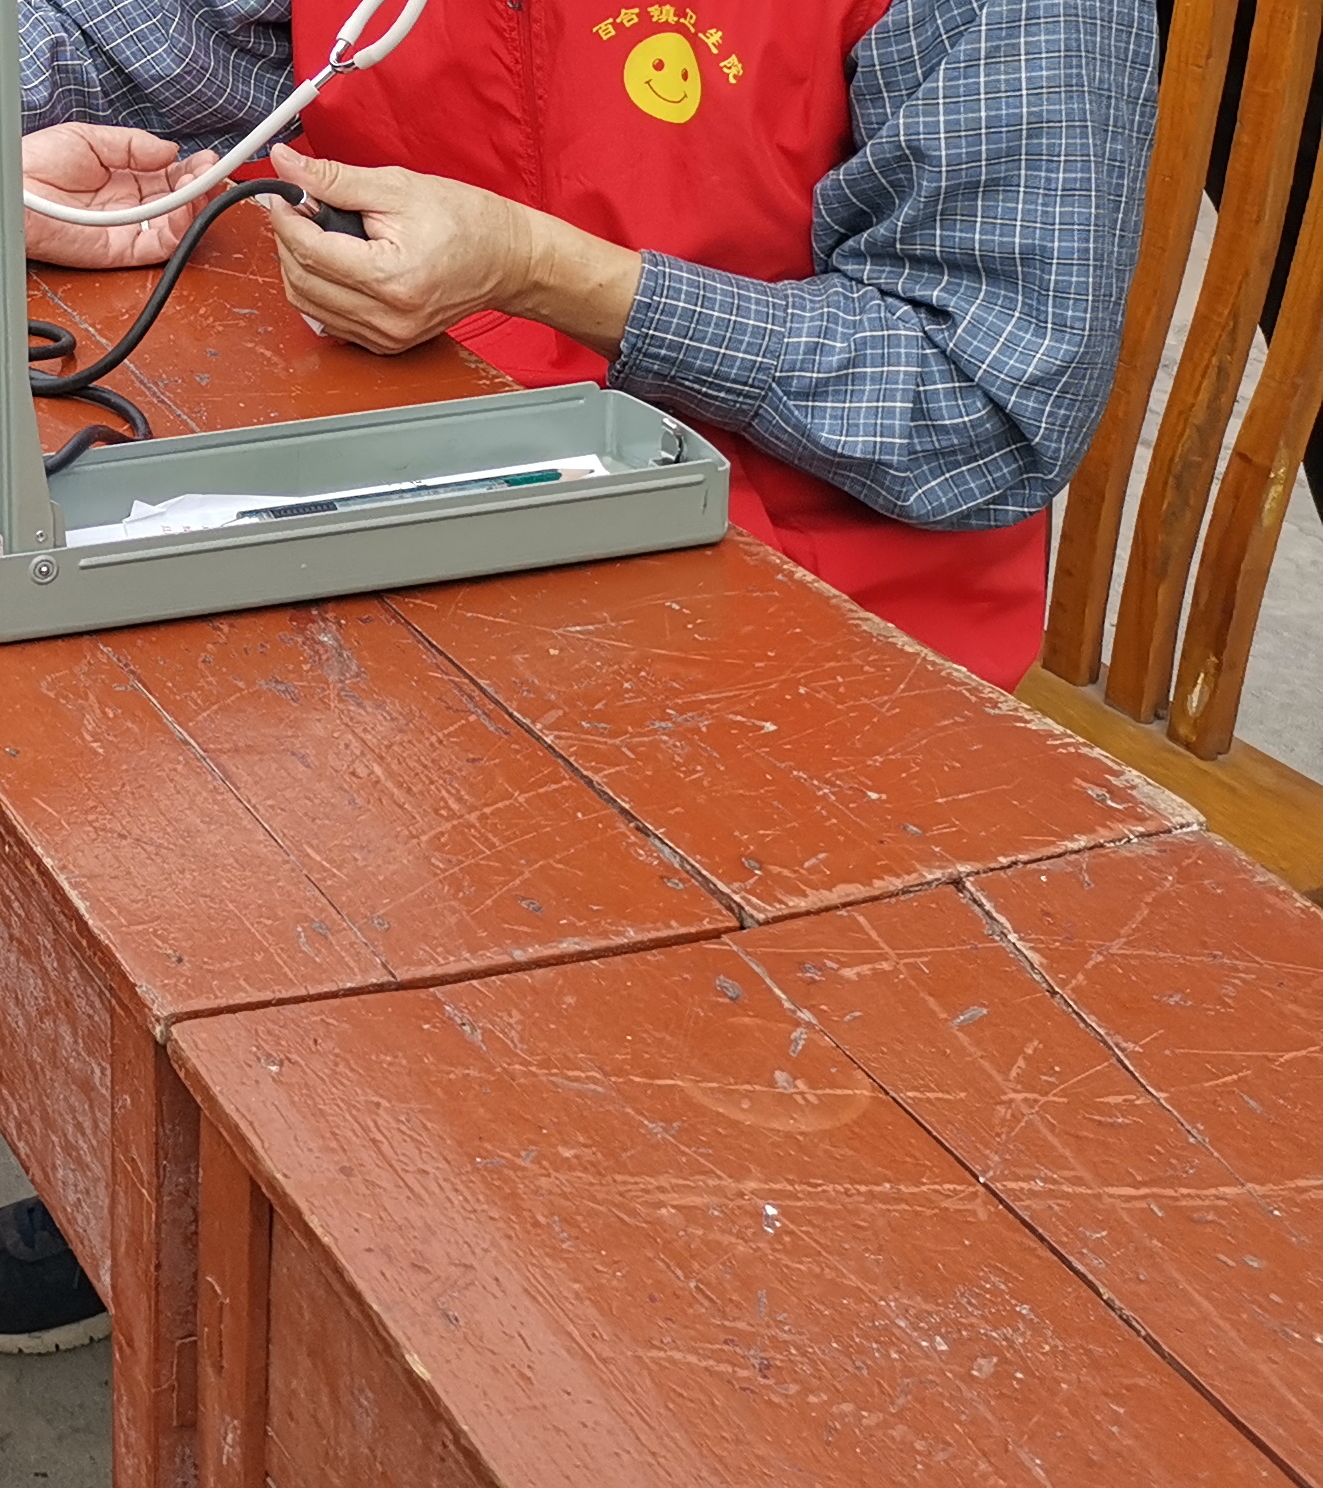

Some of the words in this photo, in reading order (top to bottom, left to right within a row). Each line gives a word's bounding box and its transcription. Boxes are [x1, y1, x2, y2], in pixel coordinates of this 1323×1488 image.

[592, 3, 744, 85] 百合镇卫生院
